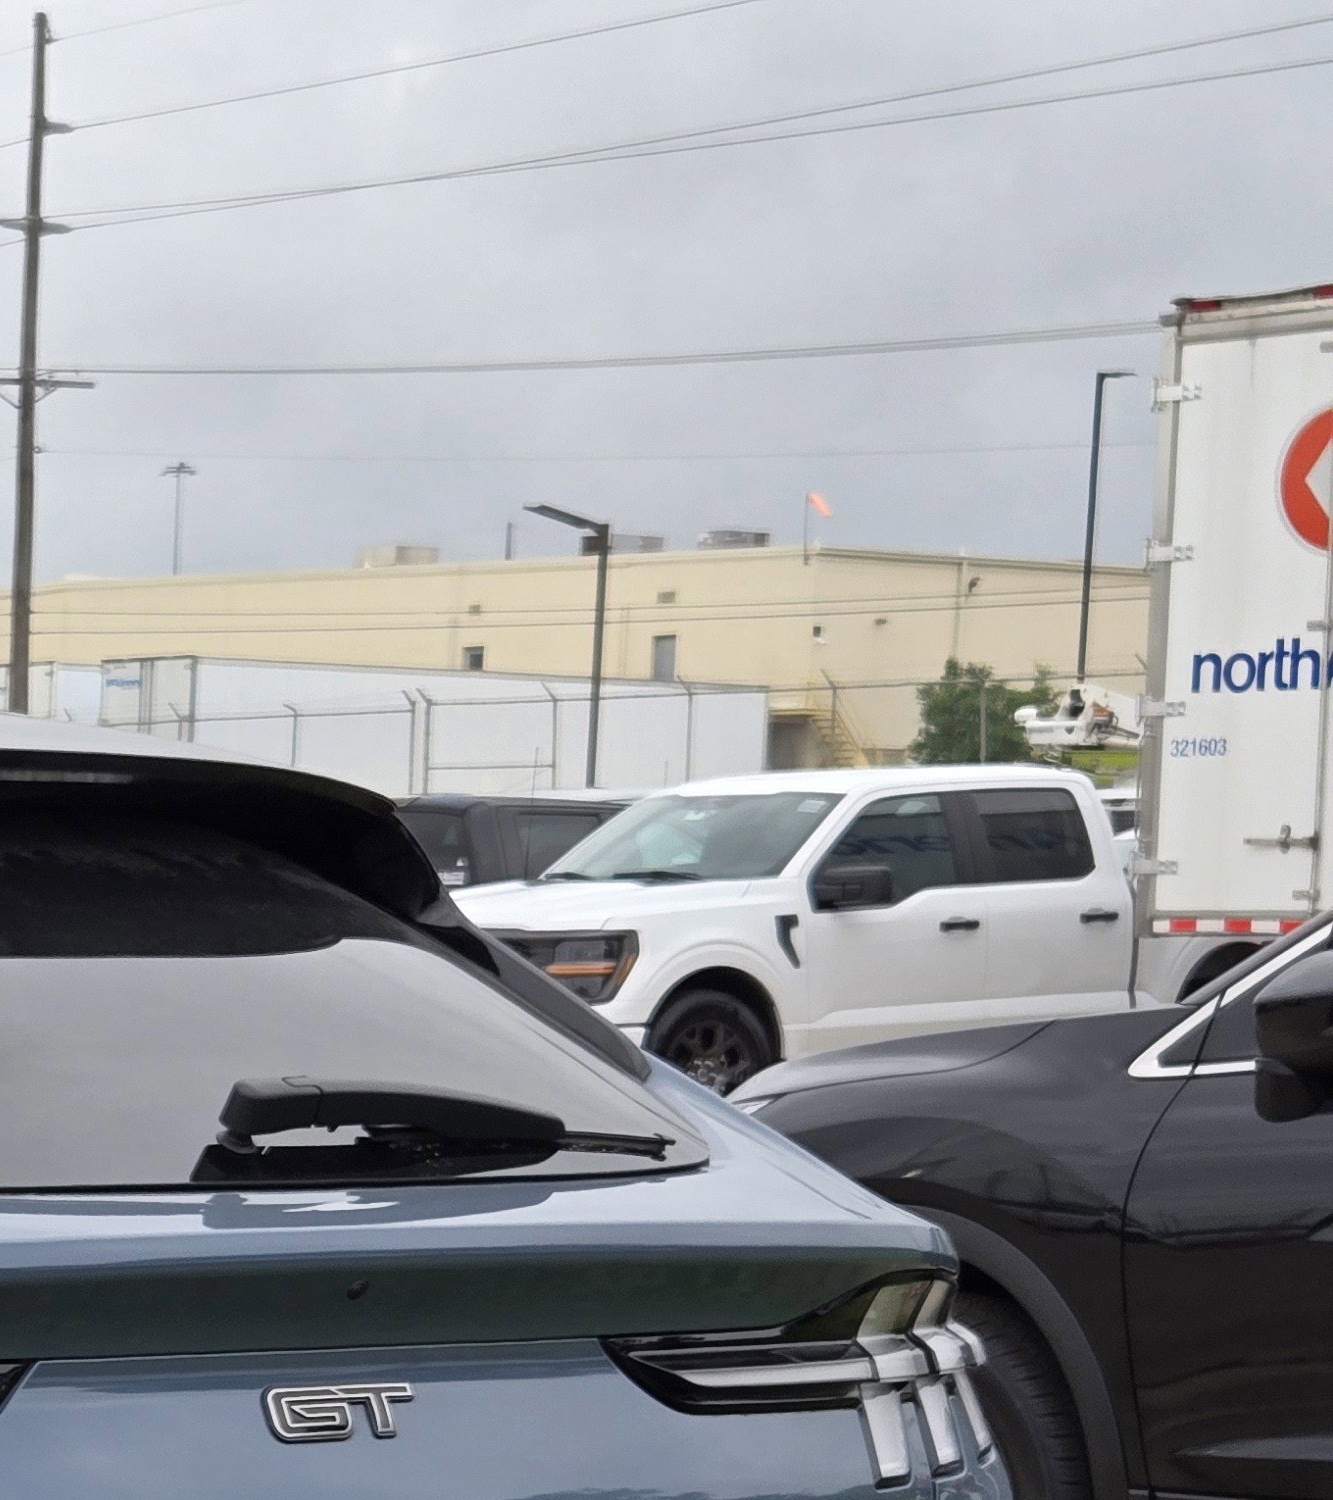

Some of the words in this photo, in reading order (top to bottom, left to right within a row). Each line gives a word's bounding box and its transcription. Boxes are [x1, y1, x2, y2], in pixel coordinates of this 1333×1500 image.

[1191, 636, 1333, 694] north
[1170, 738, 1228, 758] 321603
[262, 1382, 414, 1443] GT
